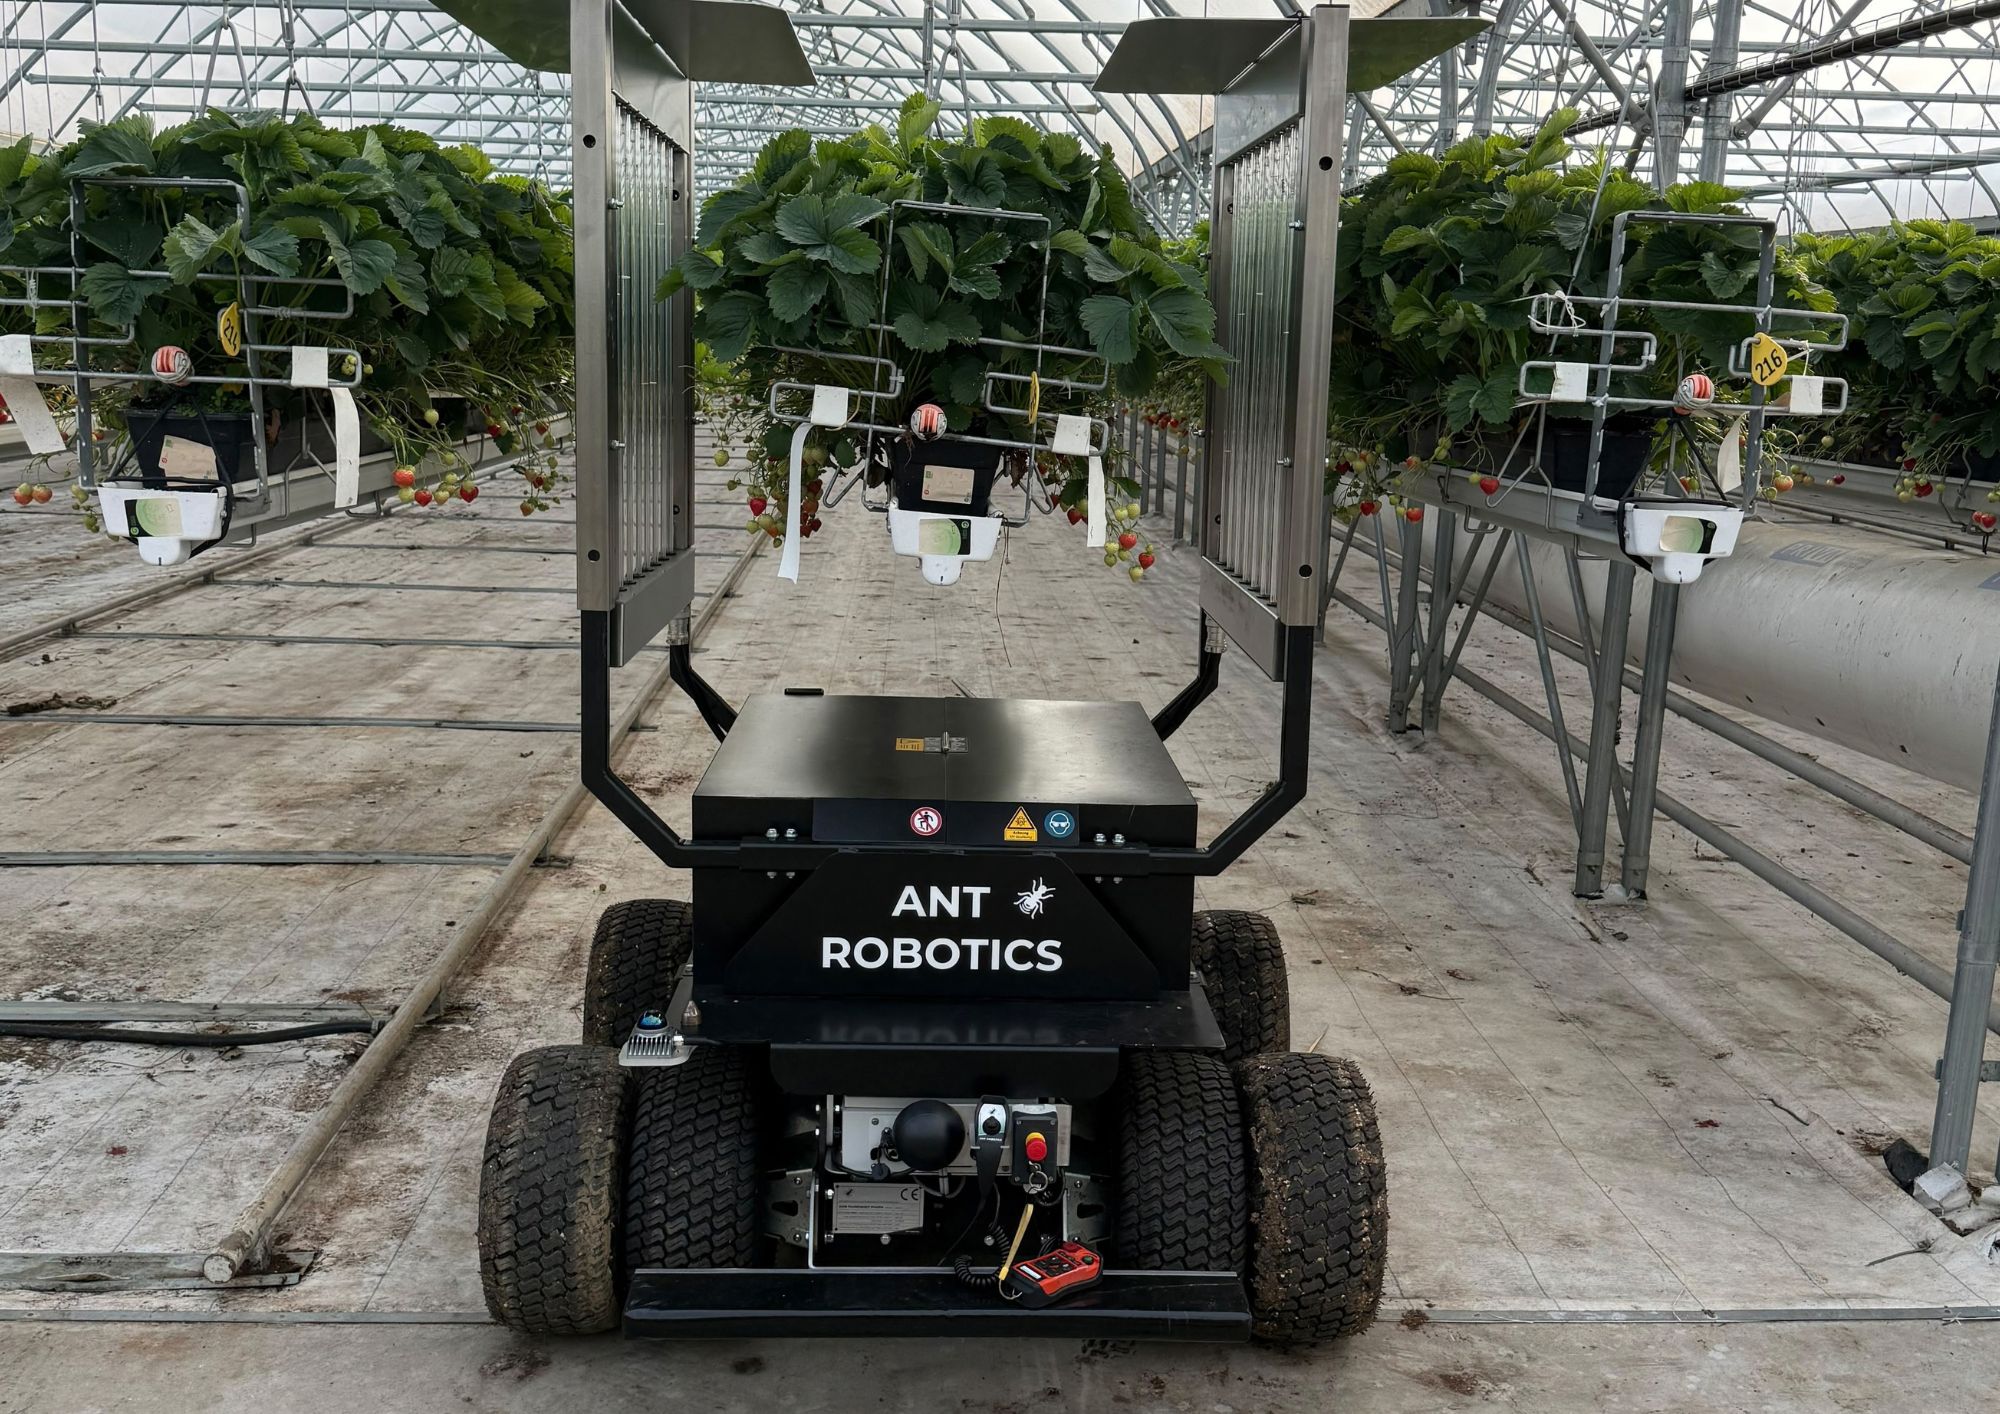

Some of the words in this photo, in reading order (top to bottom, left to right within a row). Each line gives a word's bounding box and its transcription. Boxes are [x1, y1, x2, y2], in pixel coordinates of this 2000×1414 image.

[224, 318, 238, 352] 214
[1755, 348, 1783, 382] 216
[891, 886, 990, 918] ANT
[822, 937, 1062, 972] ROBOTICS
[900, 1188, 919, 1201] CE
